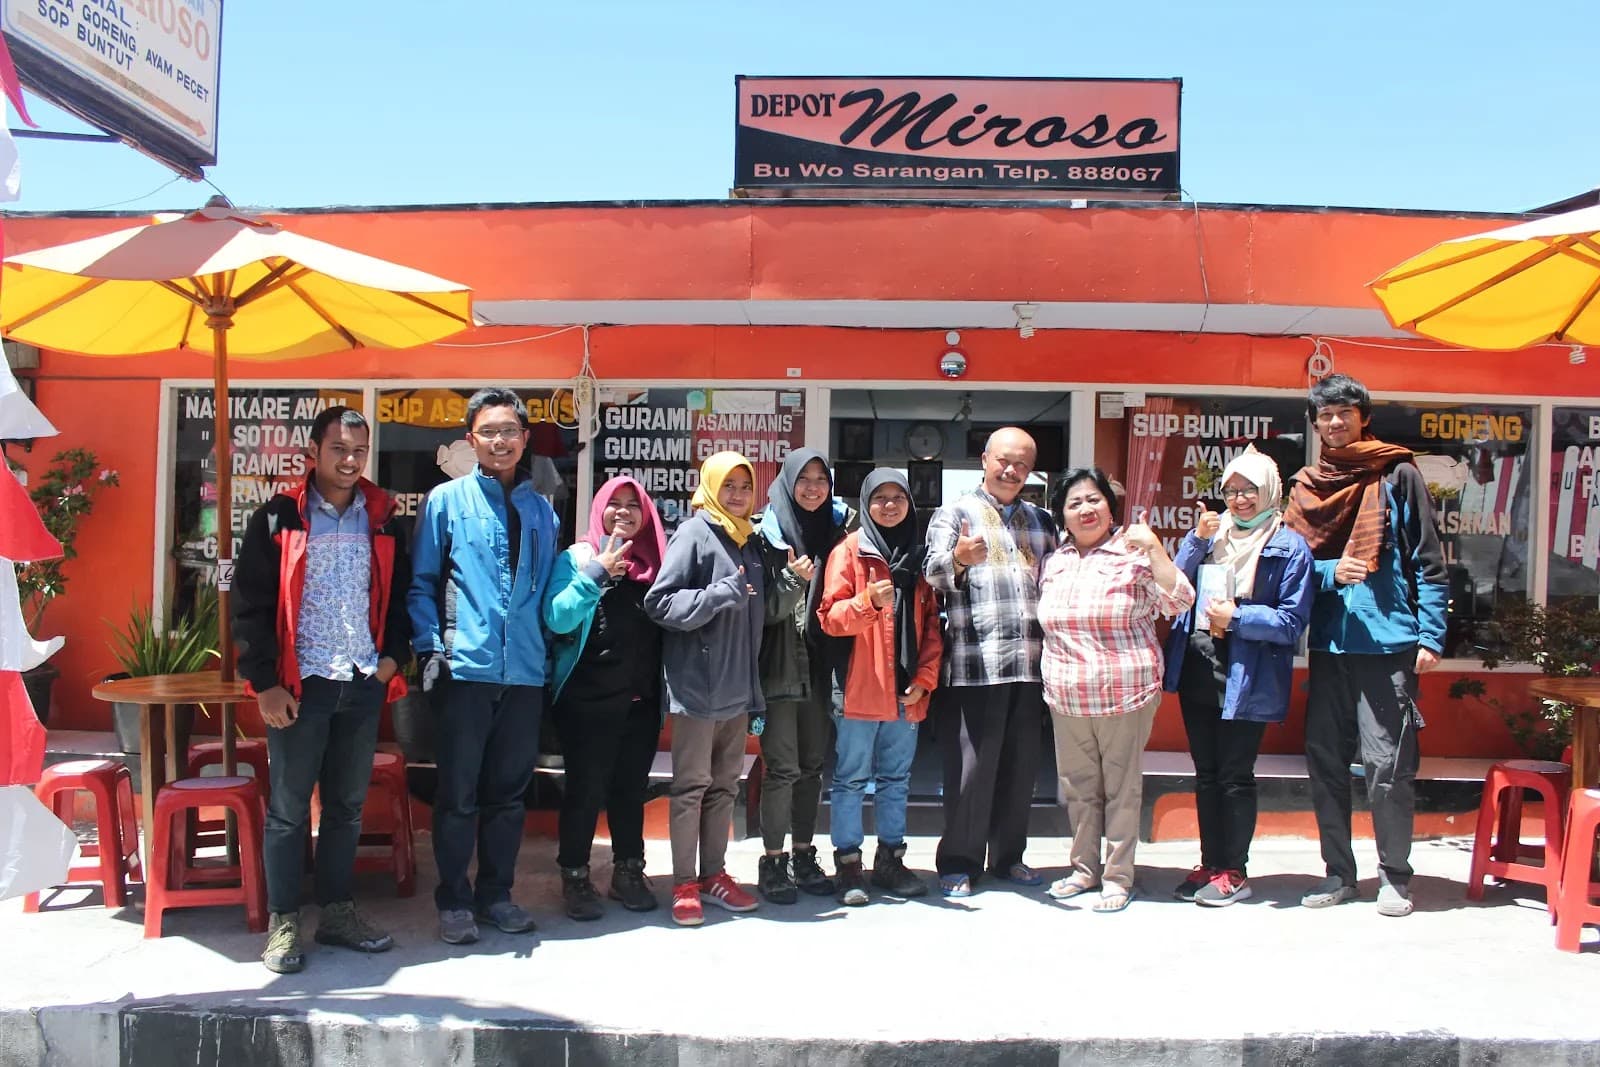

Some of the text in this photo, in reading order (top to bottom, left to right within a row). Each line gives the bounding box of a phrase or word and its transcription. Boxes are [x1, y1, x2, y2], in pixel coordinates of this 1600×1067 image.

[38, 0, 133, 71] SOP BUNTUT
[145, 48, 173, 78] AYAM
[177, 69, 208, 103] PECET
[750, 88, 1167, 151] DEPOT Miroso
[753, 163, 1164, 182] Bu Wo Sarangan Telp. 888067
[234, 397, 290, 420] KARE
[376, 398, 424, 423] SUP
[604, 407, 793, 432] GURAMI ASAM MANIS
[233, 425, 287, 448] SOTO
[1132, 413, 1273, 440] SUP BUNTUT
[1421, 412, 1523, 442] GORENG
[604, 437, 691, 461] GURAMI
[232, 453, 306, 475] RAMES
